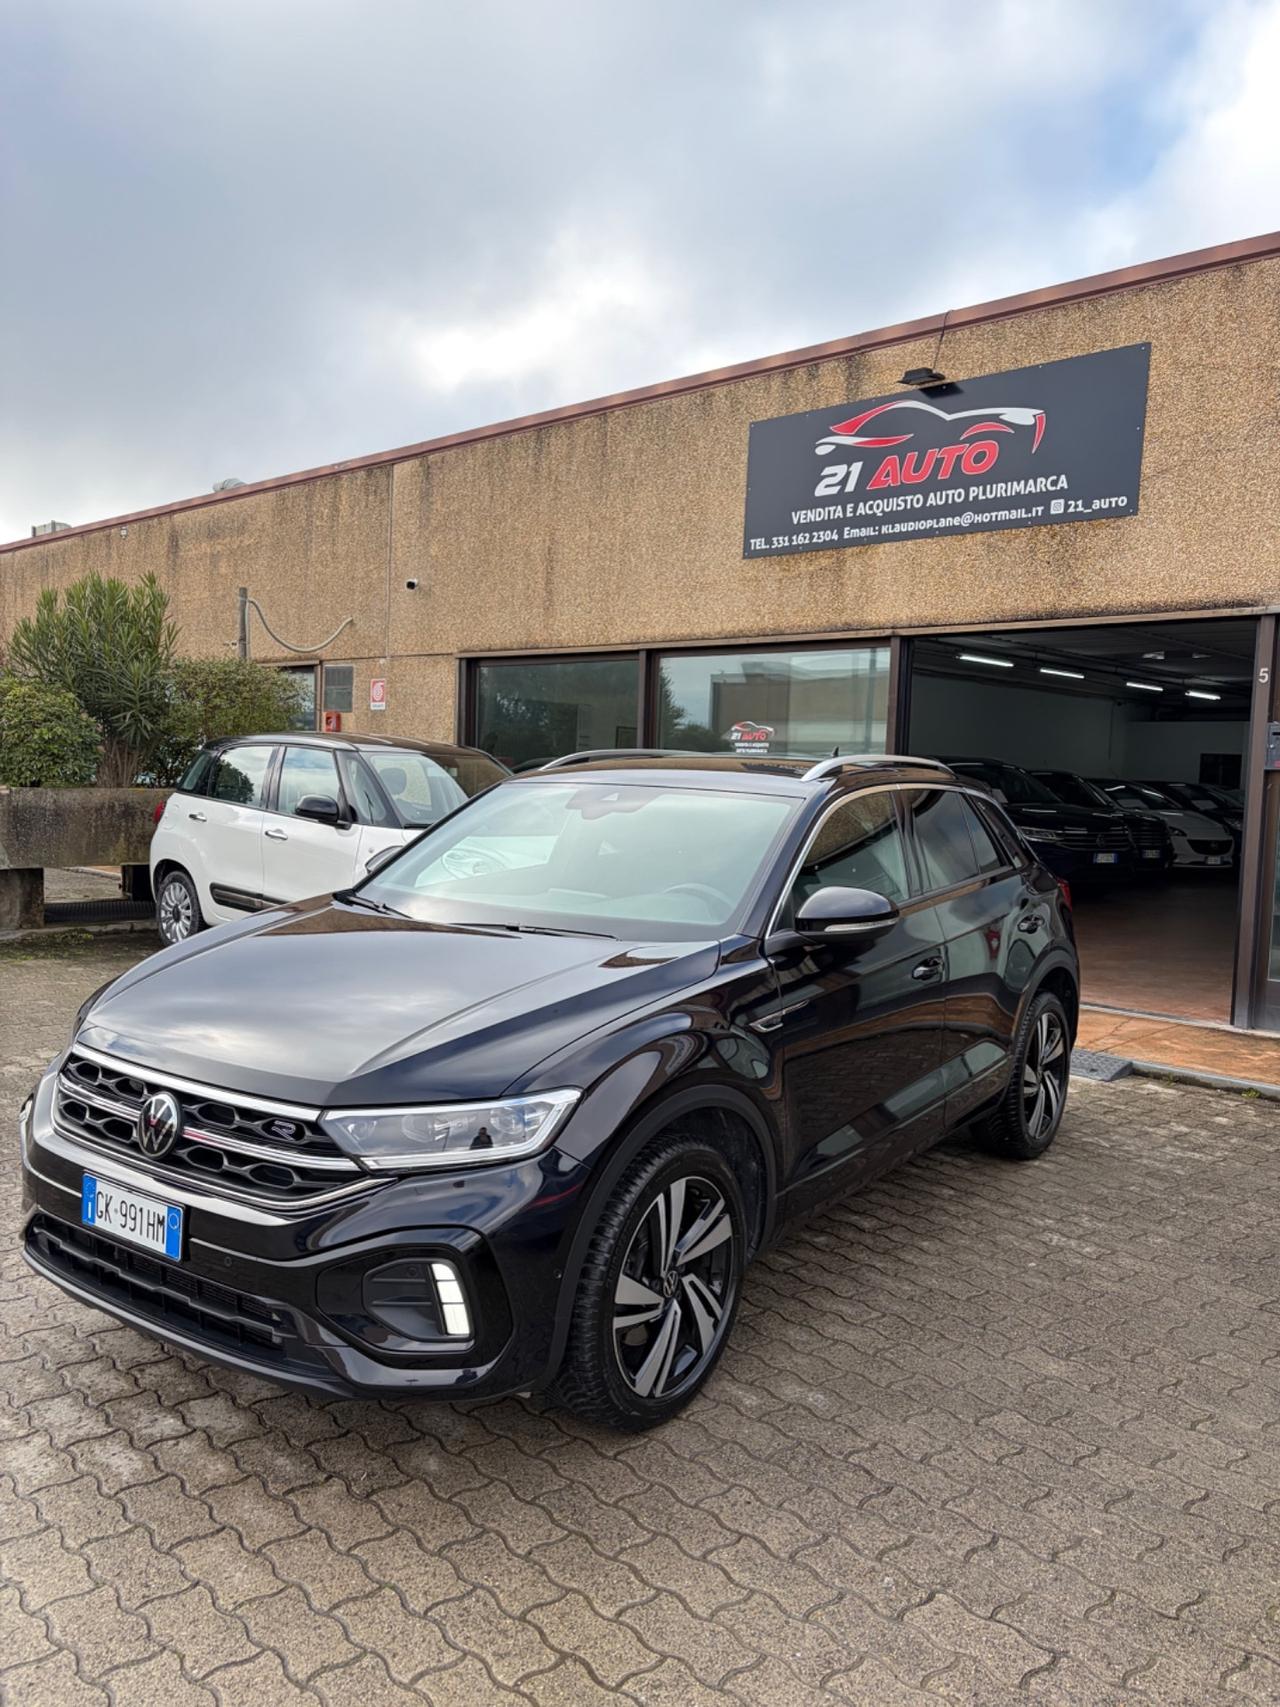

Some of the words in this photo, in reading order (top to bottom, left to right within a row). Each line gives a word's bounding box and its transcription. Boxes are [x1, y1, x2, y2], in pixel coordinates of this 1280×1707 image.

[814, 461, 863, 497] 21
[866, 440, 999, 490] AUTO
[791, 505, 843, 525] VENDITA
[846, 503, 854, 518] E
[856, 494, 923, 516] ACQUISTO
[926, 488, 965, 507] AUTO
[969, 474, 1068, 501] PLURIMARCA
[750, 538, 769, 550] TEL.
[771, 535, 789, 549] 331
[791, 533, 810, 545] 162
[812, 529, 838, 543] 2304
[1259, 668, 1269, 683] 5
